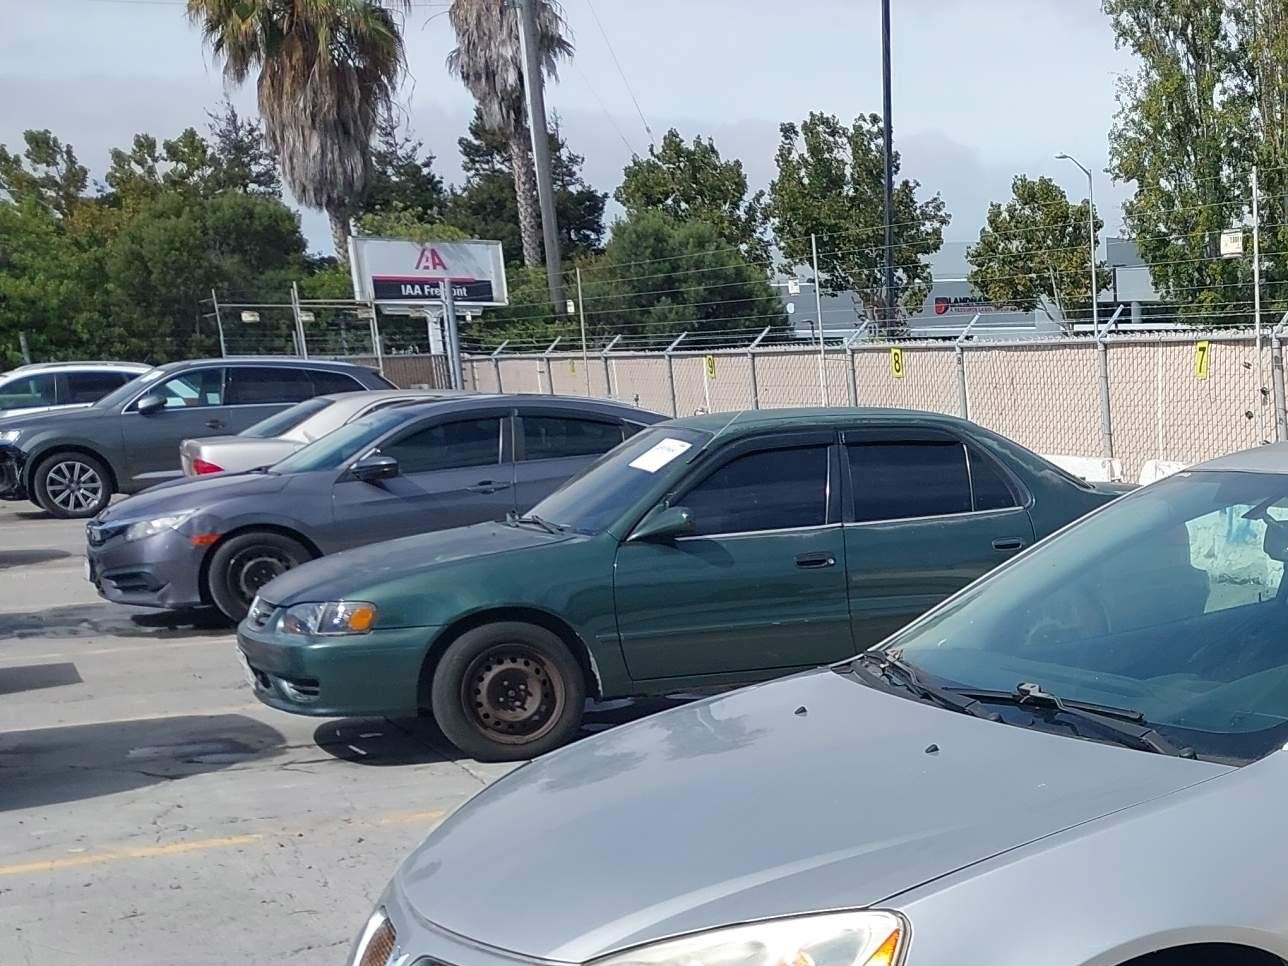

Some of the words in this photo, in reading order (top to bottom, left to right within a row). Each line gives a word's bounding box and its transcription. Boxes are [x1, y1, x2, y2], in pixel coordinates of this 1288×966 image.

[400, 284, 422, 296] IAA
[424, 284, 468, 297] Freont
[707, 357, 714, 375] 9
[893, 351, 901, 373] 8
[1198, 346, 1207, 374] 7
